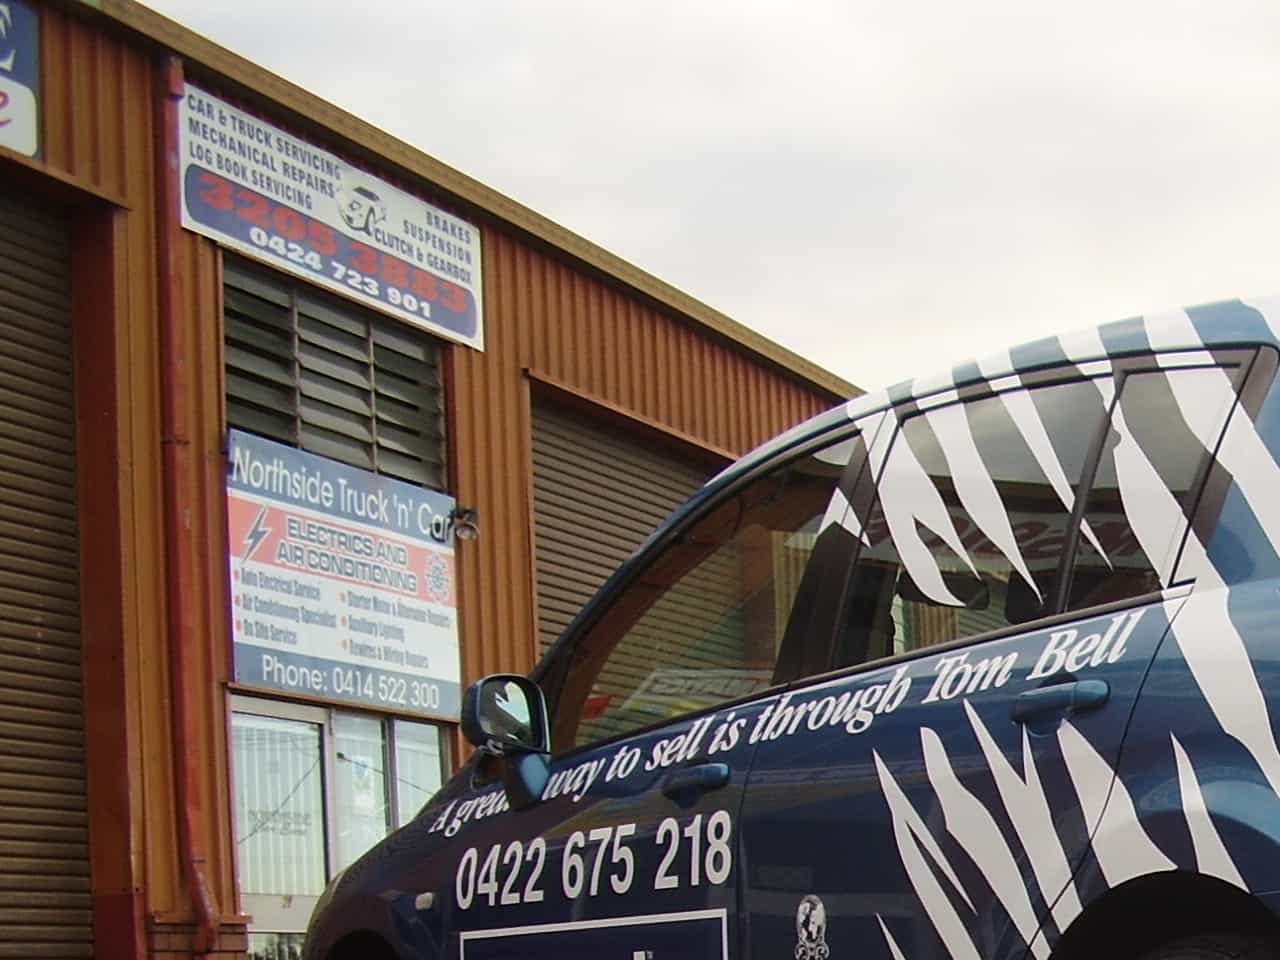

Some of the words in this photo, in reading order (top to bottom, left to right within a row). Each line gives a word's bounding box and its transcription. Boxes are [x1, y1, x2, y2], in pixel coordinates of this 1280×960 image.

[187, 94, 215, 120] CAR
[218, 109, 227, 127] &
[230, 114, 273, 149] TRUCK
[276, 137, 341, 181] SERVICING
[188, 117, 277, 172] MECHANICAL
[282, 160, 335, 198] REPAIRS
[189, 141, 213, 165] LOG
[216, 153, 248, 182] BOOK
[251, 170, 312, 210] SERVICING
[374, 228, 414, 258] CLUTCH
[426, 252, 472, 285] GEARBOX
[403, 219, 472, 265] SUSPENSION
[426, 211, 471, 244] BRAKES
[249, 226, 322, 272] 0424
[331, 260, 379, 296] 723
[386, 287, 431, 318] 901
[232, 447, 334, 508] Northside
[337, 478, 390, 523] Truck
[277, 540, 305, 565] AIR
[307, 550, 417, 592] CONDITIONING
[287, 517, 374, 557] ELECTRICS
[376, 540, 408, 565] AND
[262, 654, 328, 691] Phone:
[333, 667, 373, 700] 0414
[378, 676, 406, 704] 522
[410, 681, 440, 709] 300
[428, 799, 454, 833] A
[444, 789, 511, 837] grea
[541, 757, 606, 802] way
[605, 746, 641, 783] to
[644, 713, 717, 772] sell
[708, 711, 747, 755] is
[749, 664, 912, 745] through
[921, 652, 1019, 705] Tom
[1025, 608, 1148, 681] Bell
[455, 836, 547, 911] 0422
[562, 823, 636, 899] 675
[654, 810, 732, 890] 218
